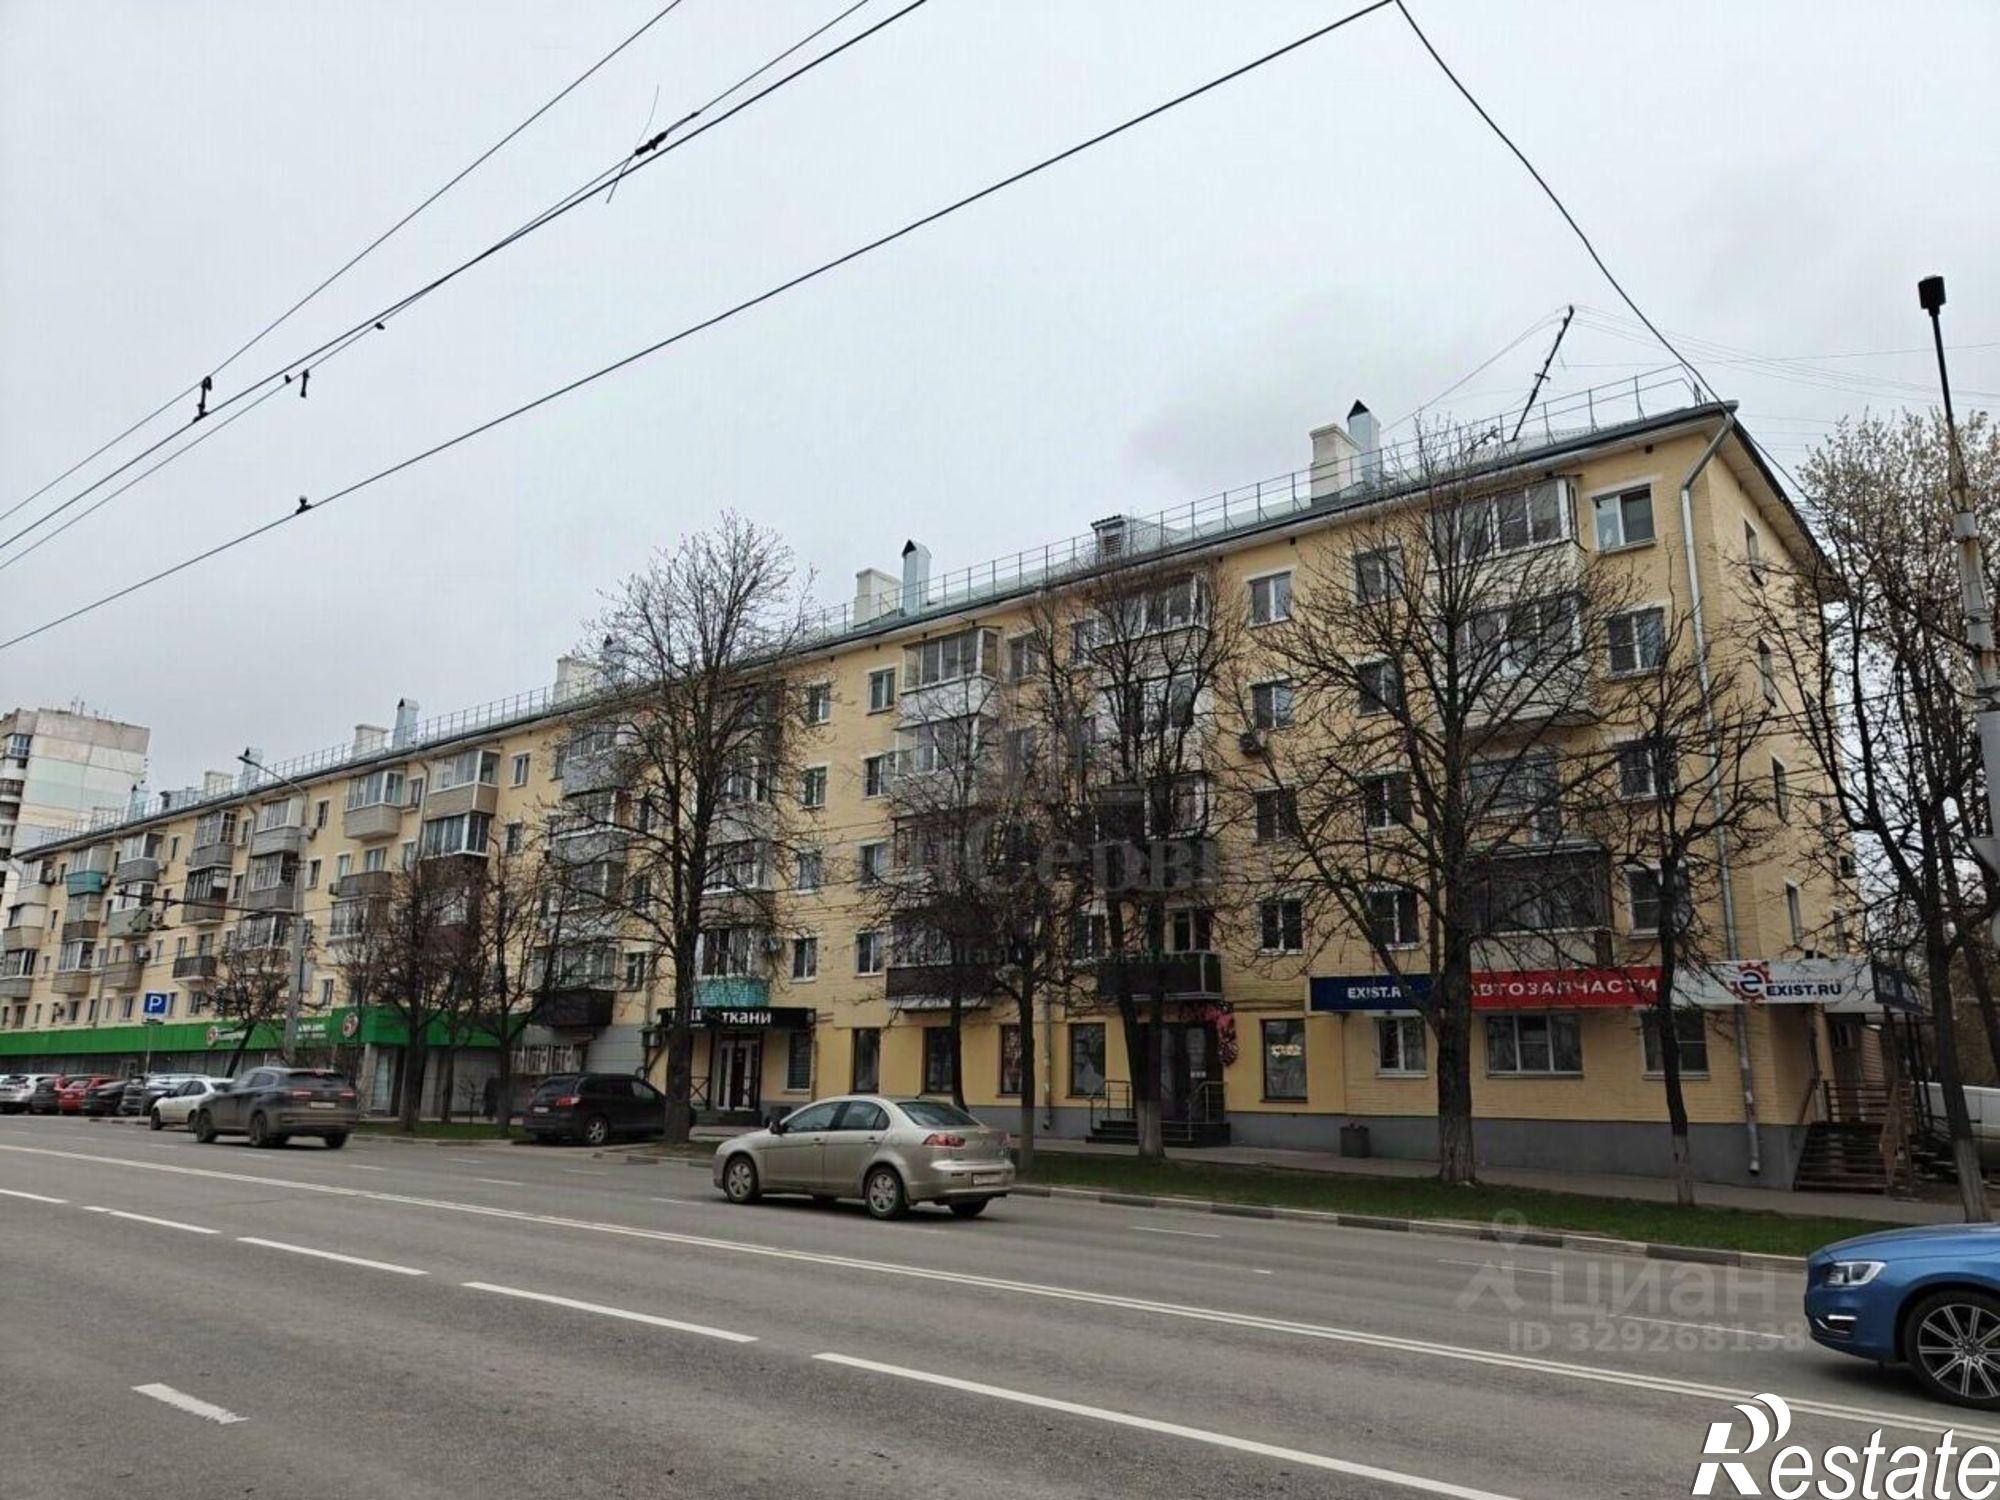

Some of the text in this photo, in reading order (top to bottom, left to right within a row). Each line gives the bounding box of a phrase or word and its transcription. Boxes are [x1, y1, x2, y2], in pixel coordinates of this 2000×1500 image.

[1346, 985, 1412, 1000] EXIST.R
[1766, 983, 1842, 997] EXIST.RU
[149, 995, 163, 1011] P
